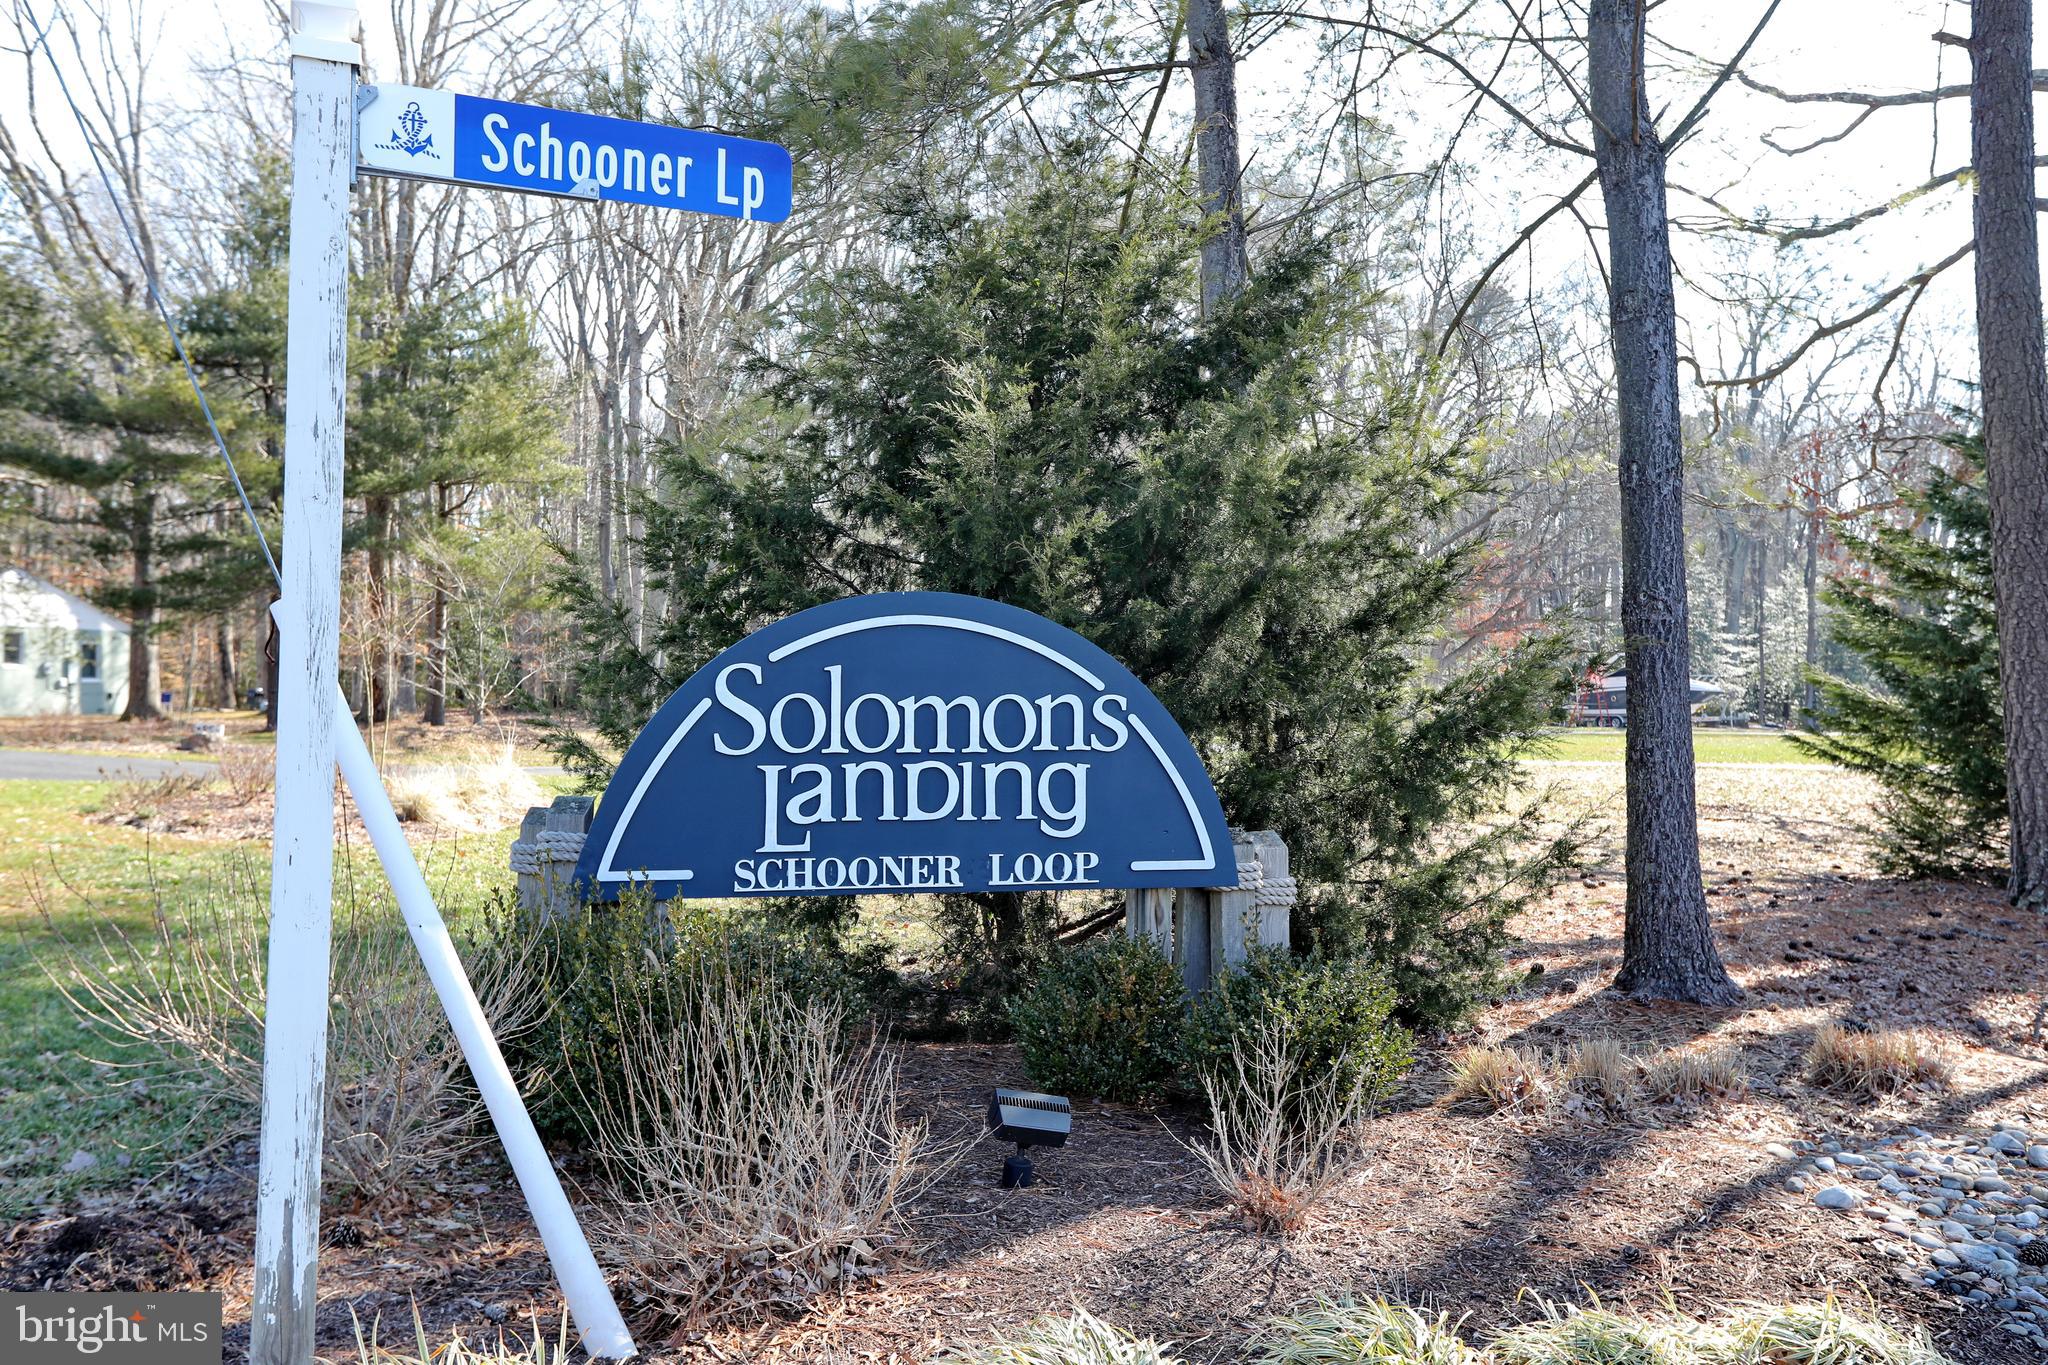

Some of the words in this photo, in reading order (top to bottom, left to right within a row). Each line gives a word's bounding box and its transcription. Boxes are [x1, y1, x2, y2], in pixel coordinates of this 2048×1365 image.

[481, 112, 694, 198] Schooner
[716, 148, 765, 220] Lp
[713, 662, 1129, 756] Solomons
[734, 855, 963, 892] SCHOONER
[988, 852, 1099, 886] LOOP
